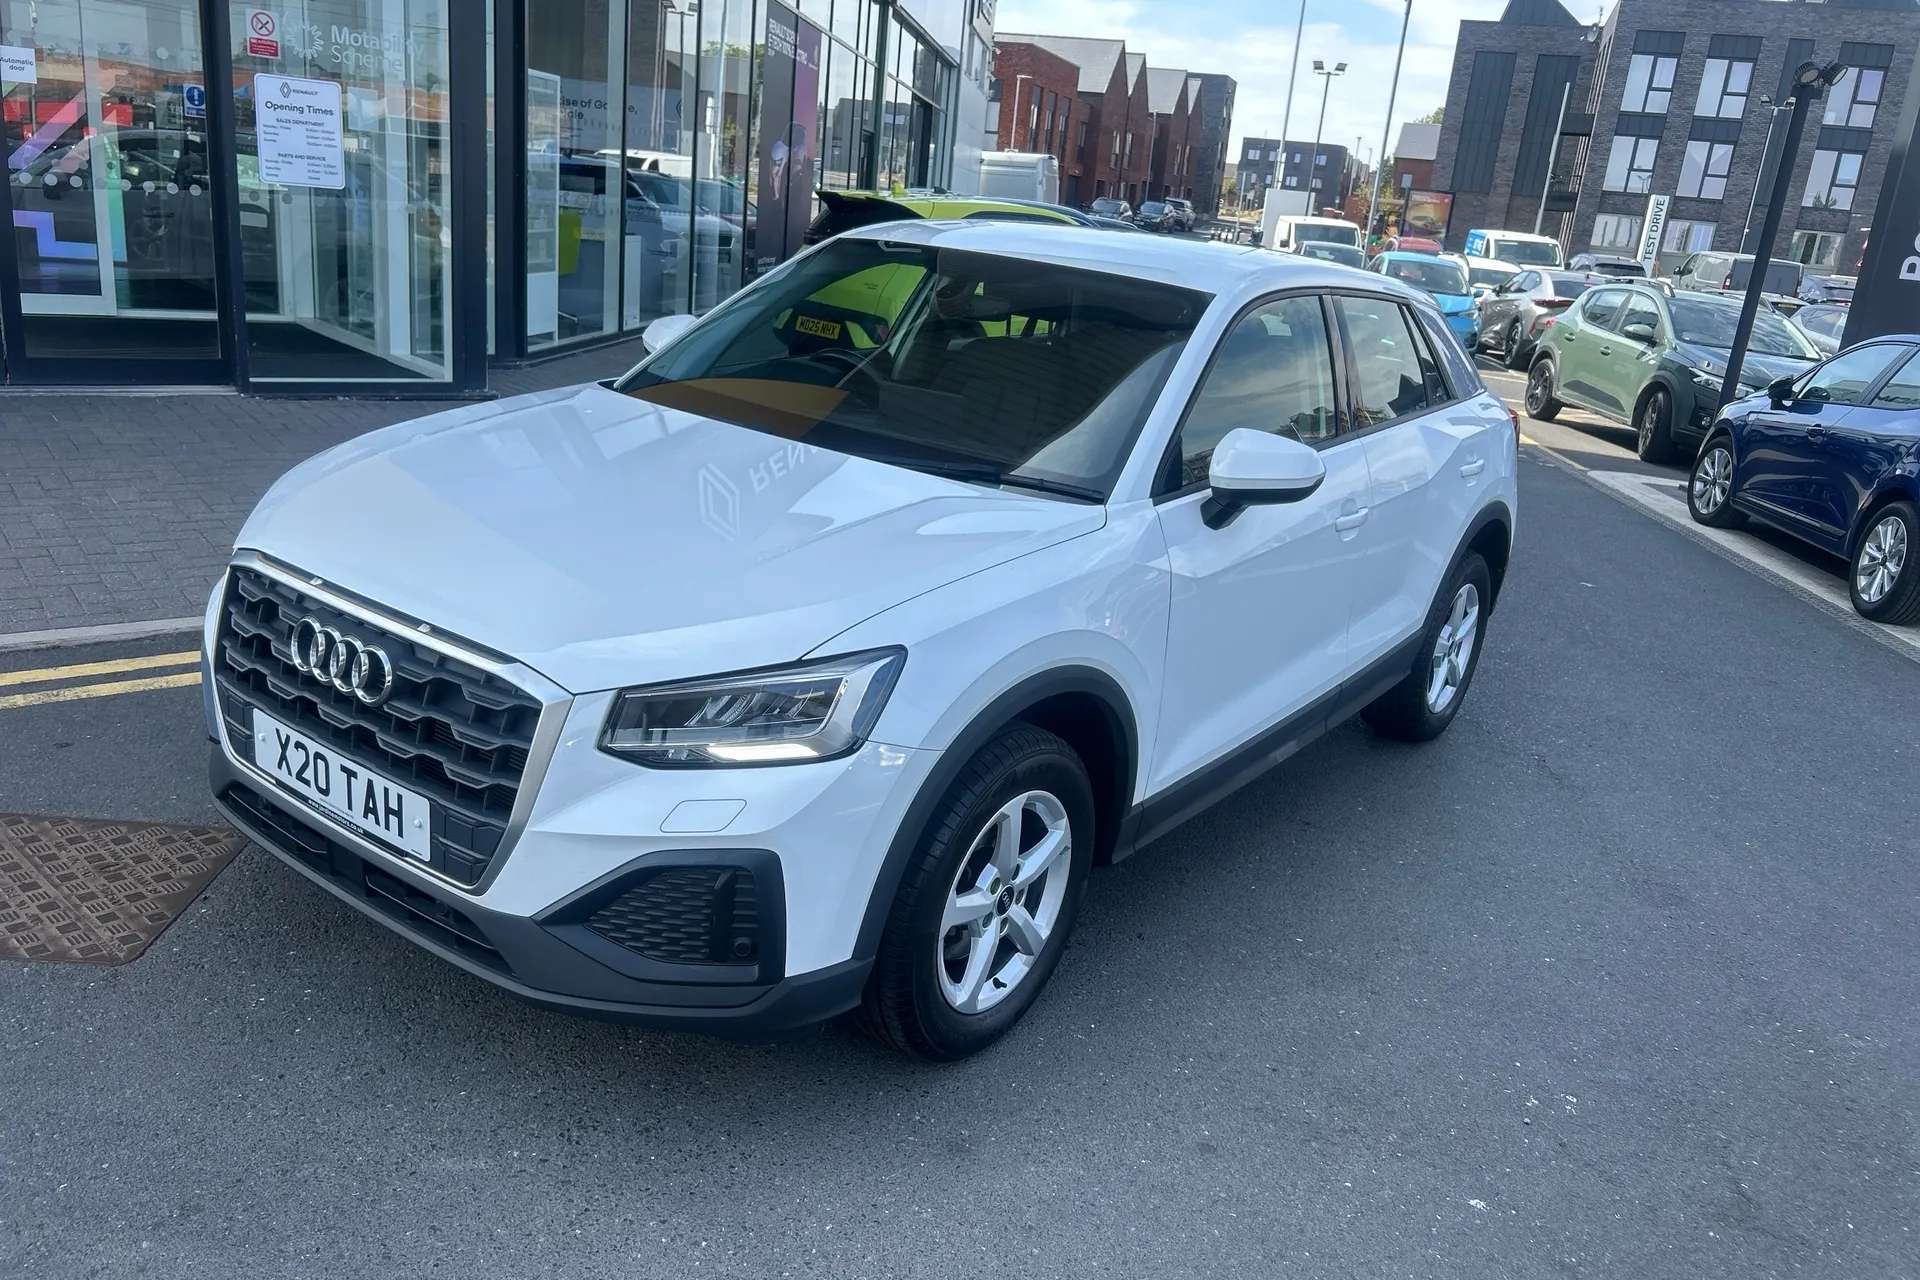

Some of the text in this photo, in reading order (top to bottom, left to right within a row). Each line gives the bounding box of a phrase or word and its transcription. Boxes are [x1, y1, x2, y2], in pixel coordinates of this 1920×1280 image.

[265, 100, 334, 116] Opening Times
[1643, 199, 1666, 261] TEST DRIVE
[275, 727, 404, 839] X20 TAH
